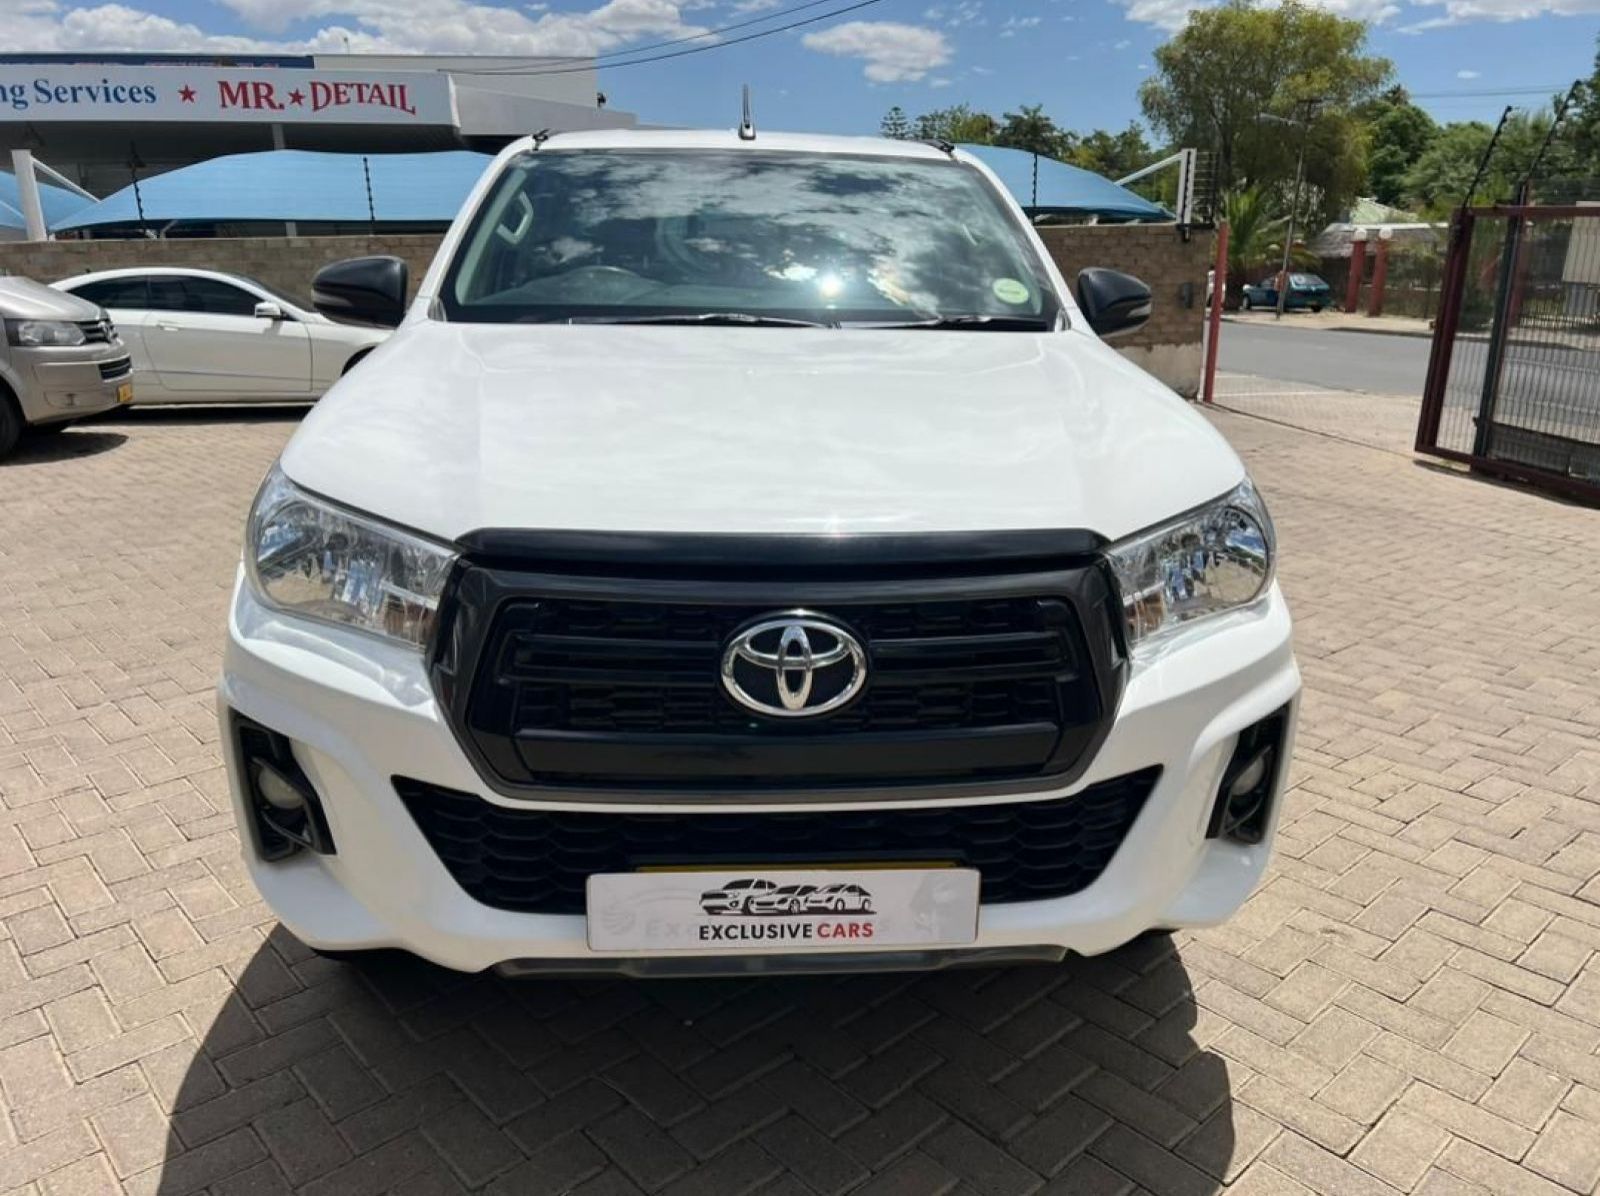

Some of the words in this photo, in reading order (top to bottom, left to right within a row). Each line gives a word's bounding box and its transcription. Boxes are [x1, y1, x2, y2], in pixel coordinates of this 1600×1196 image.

[33, 78, 157, 103] Services
[217, 80, 285, 110] MR.
[309, 81, 416, 115] DETAIL
[699, 923, 812, 940] EXCLUSIVE
[816, 922, 874, 938] CARS
